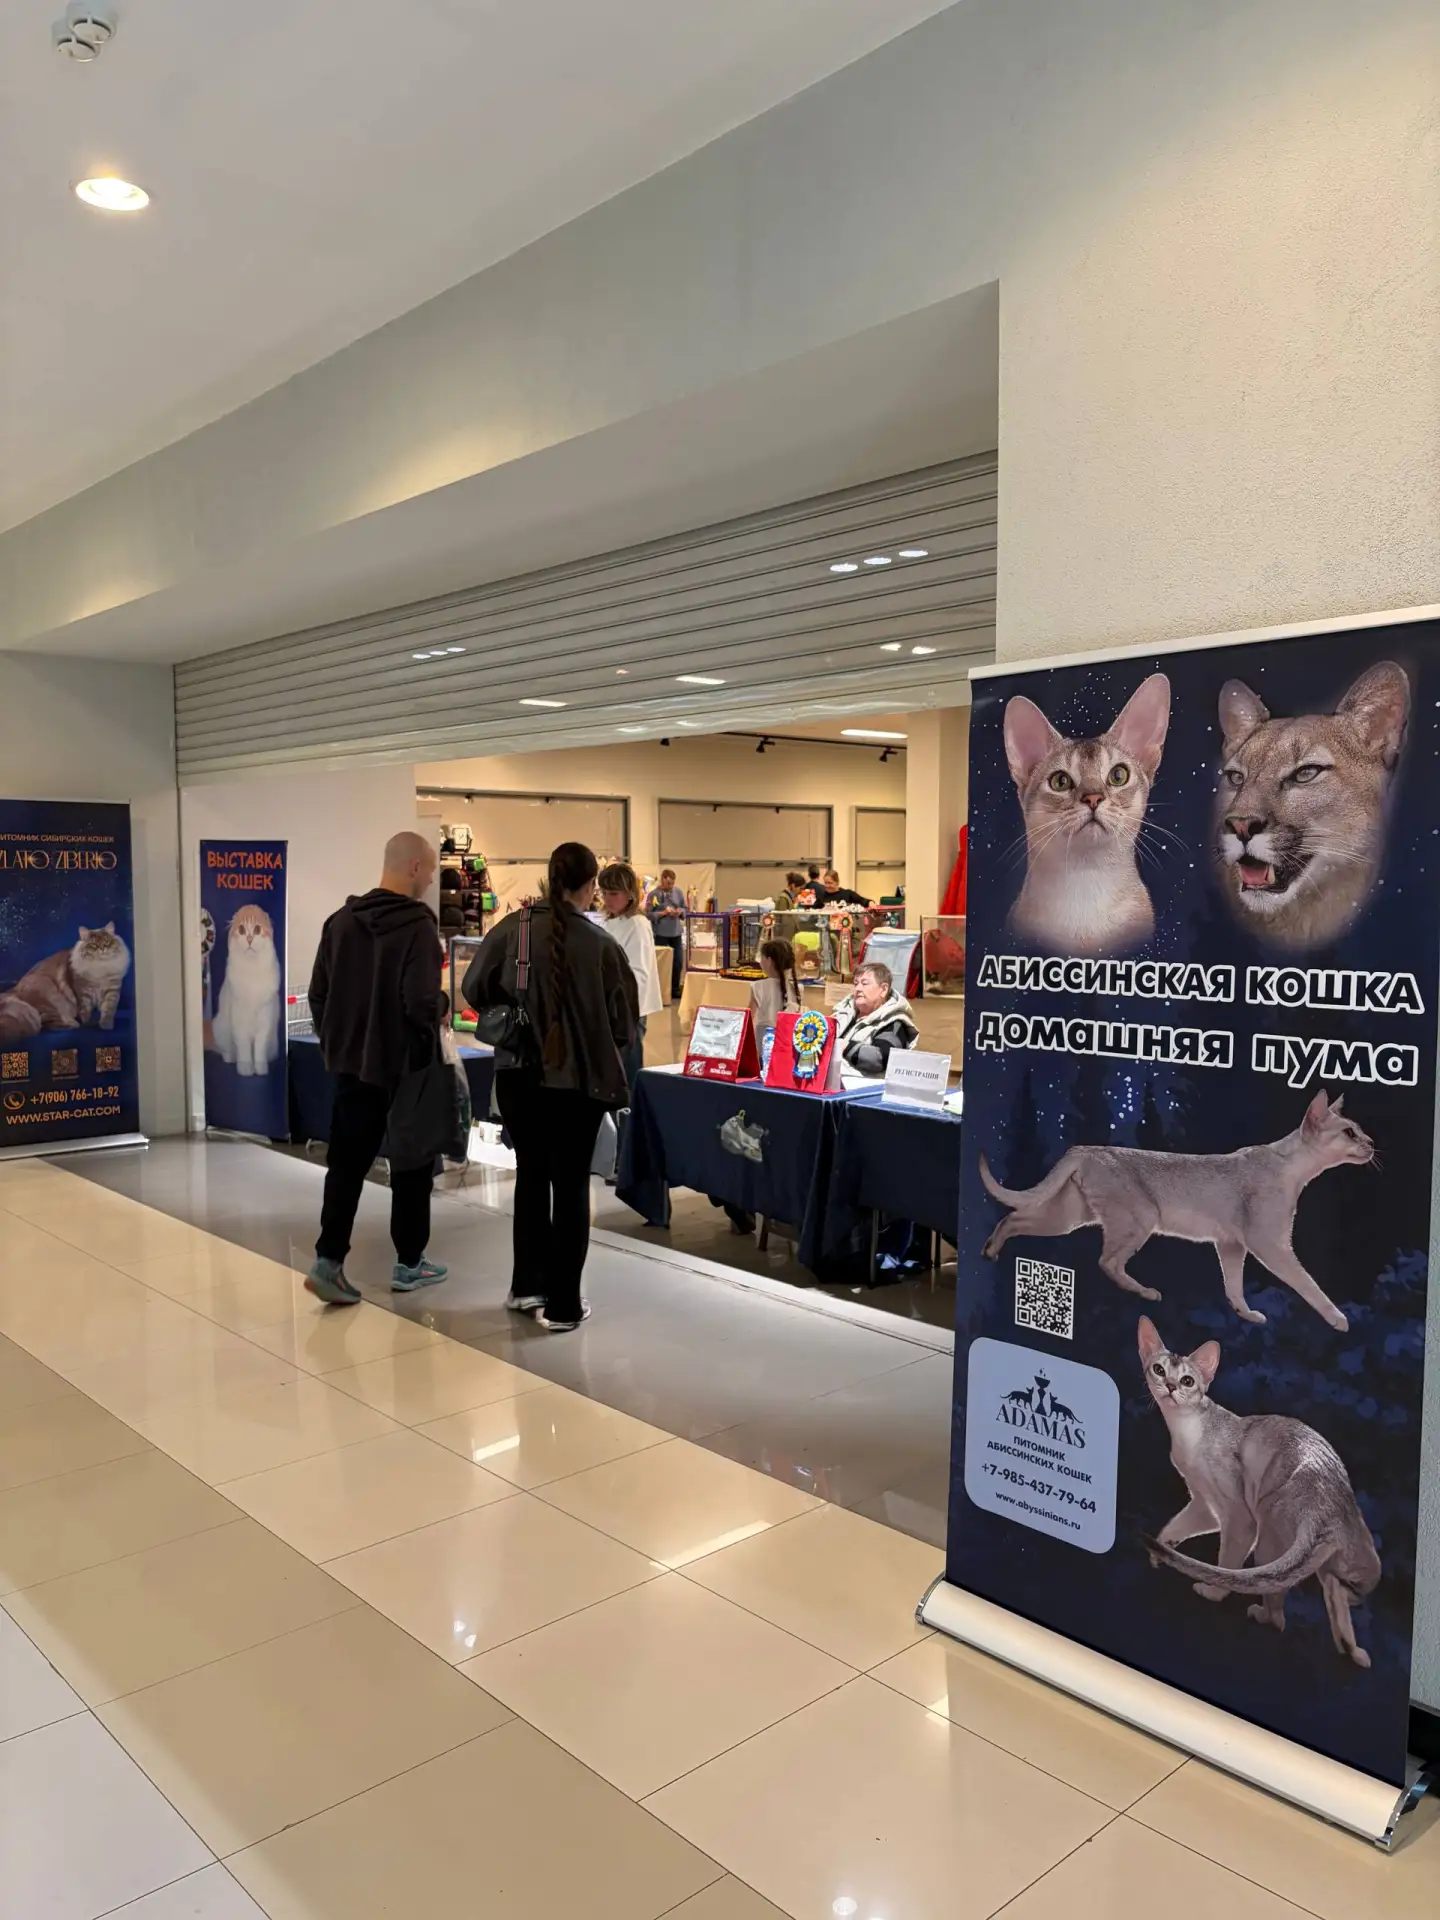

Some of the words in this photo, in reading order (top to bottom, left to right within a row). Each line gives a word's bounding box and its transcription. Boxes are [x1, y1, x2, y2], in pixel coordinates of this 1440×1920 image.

[0, 833, 39, 841] ИТОМНИК
[207, 850, 284, 869] ВЫСТАВКА
[216, 873, 274, 891] КОШЕК
[977, 954, 1235, 1002] АБИССИНСКАЯ
[1246, 964, 1425, 1015] КОШКА
[1251, 1032, 1419, 1089] пума
[31, 1091, 68, 1105] +7(906)
[6, 1105, 121, 1125] WWW.STAR-CAT.COM
[995, 1403, 1086, 1449] ADAMAS
[987, 1440, 1055, 1471] АБИССИНСКИХ
[1056, 1463, 1092, 1485] КОШЕК
[1013, 1435, 1066, 1462] ПИТОМНИК
[981, 1463, 1097, 1514] +7-985-437-79-64
[995, 1491, 1081, 1531] www.abyssinians.ru
